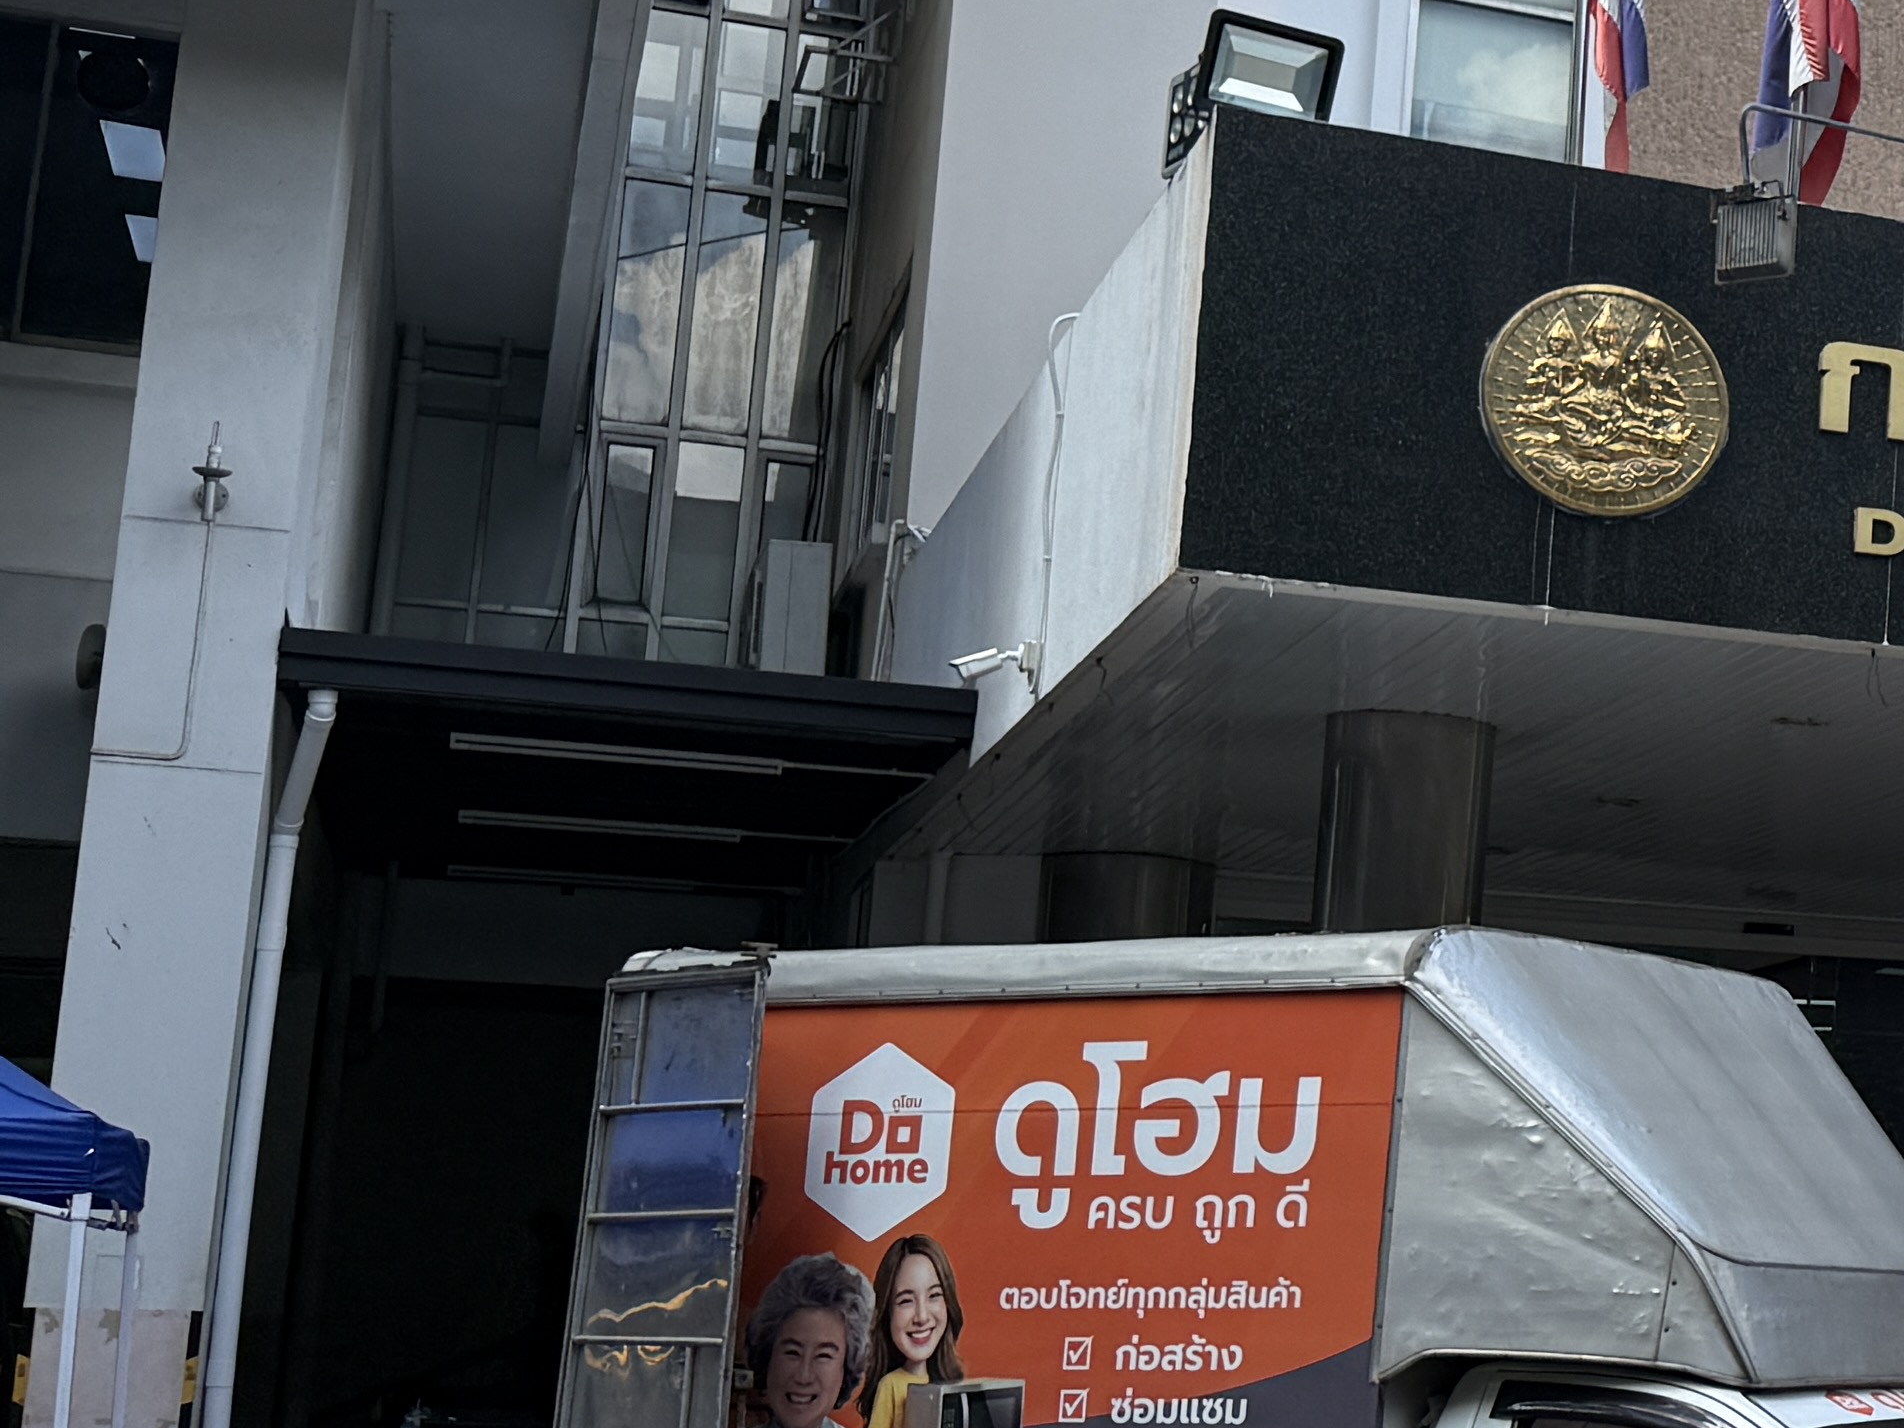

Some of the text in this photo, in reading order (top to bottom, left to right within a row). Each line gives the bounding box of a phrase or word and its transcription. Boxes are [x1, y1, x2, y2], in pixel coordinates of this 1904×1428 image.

[993, 1040, 1322, 1231] ดูโฮม
[823, 1150, 929, 1185] home
[1086, 1178, 1309, 1245] ครบ ถูก ดี
[997, 1279, 1303, 1321] ตอบโจทย์ทุกกลุ่มสินค้า
[1113, 1335, 1243, 1375] ก่อสร้าง
[1109, 1390, 1249, 1428] ซ่อมแซม
